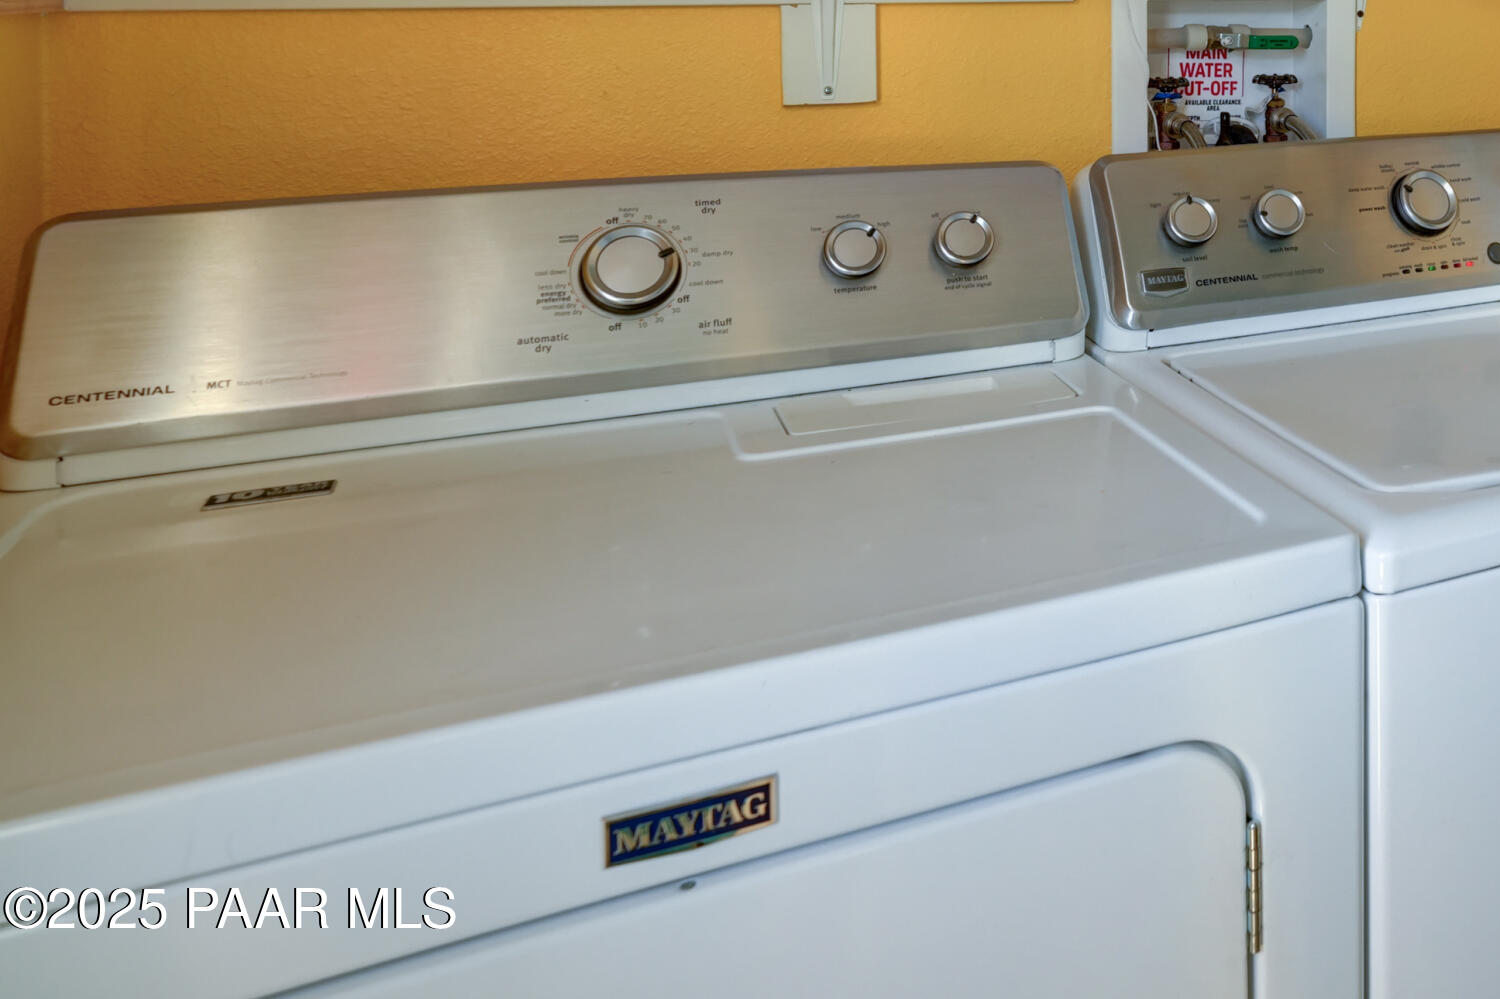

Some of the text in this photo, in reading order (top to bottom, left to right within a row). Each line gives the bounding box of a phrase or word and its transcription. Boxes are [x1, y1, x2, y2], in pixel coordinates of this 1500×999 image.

[1186, 48, 1228, 59] MAIN
[1180, 62, 1233, 78] WATER
[694, 198, 721, 207] timed
[701, 206, 716, 215] dry
[606, 217, 619, 225] off
[946, 276, 964, 284] push
[974, 274, 989, 282] start
[1147, 274, 1184, 285] MAYTAG
[1196, 274, 1259, 287] CENTENNIAL
[540, 290, 567, 298] energy
[834, 284, 877, 295] temperature
[536, 296, 571, 305] preferred
[677, 295, 690, 304] off
[608, 322, 622, 332] off
[699, 318, 733, 329] air fluff
[516, 334, 569, 345] automatic
[535, 344, 552, 354] dry
[48, 384, 175, 406] CENTENNIAL
[206, 380, 231, 391] MCT
[216, 489, 265, 503] 10
[613, 792, 768, 856] MAYTAG
